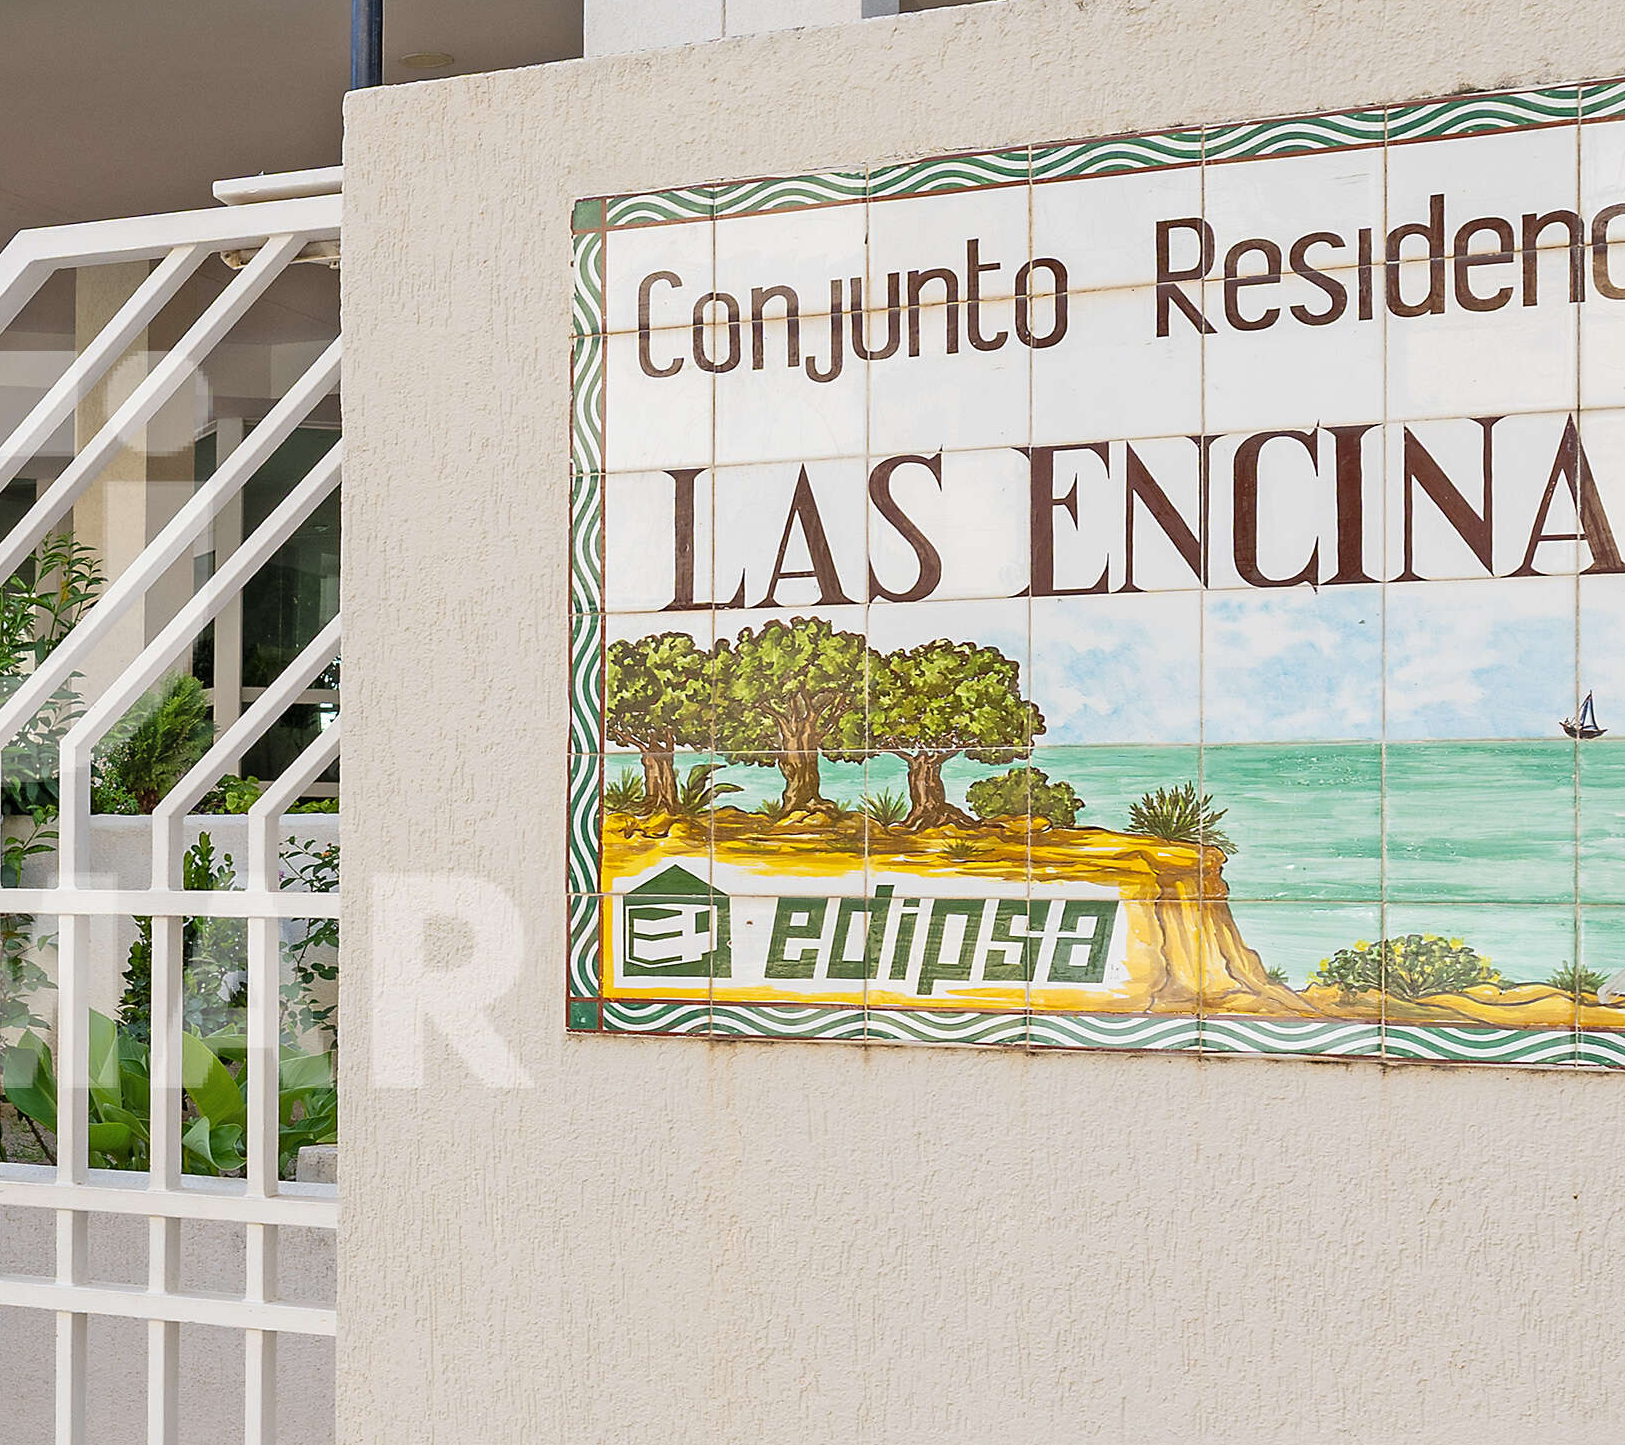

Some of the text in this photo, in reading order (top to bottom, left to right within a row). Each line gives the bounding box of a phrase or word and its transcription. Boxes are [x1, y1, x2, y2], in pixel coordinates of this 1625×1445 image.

[637, 238, 1067, 383] Conjunto
[661, 446, 943, 611] LAS
[764, 885, 1120, 995] edipsa
